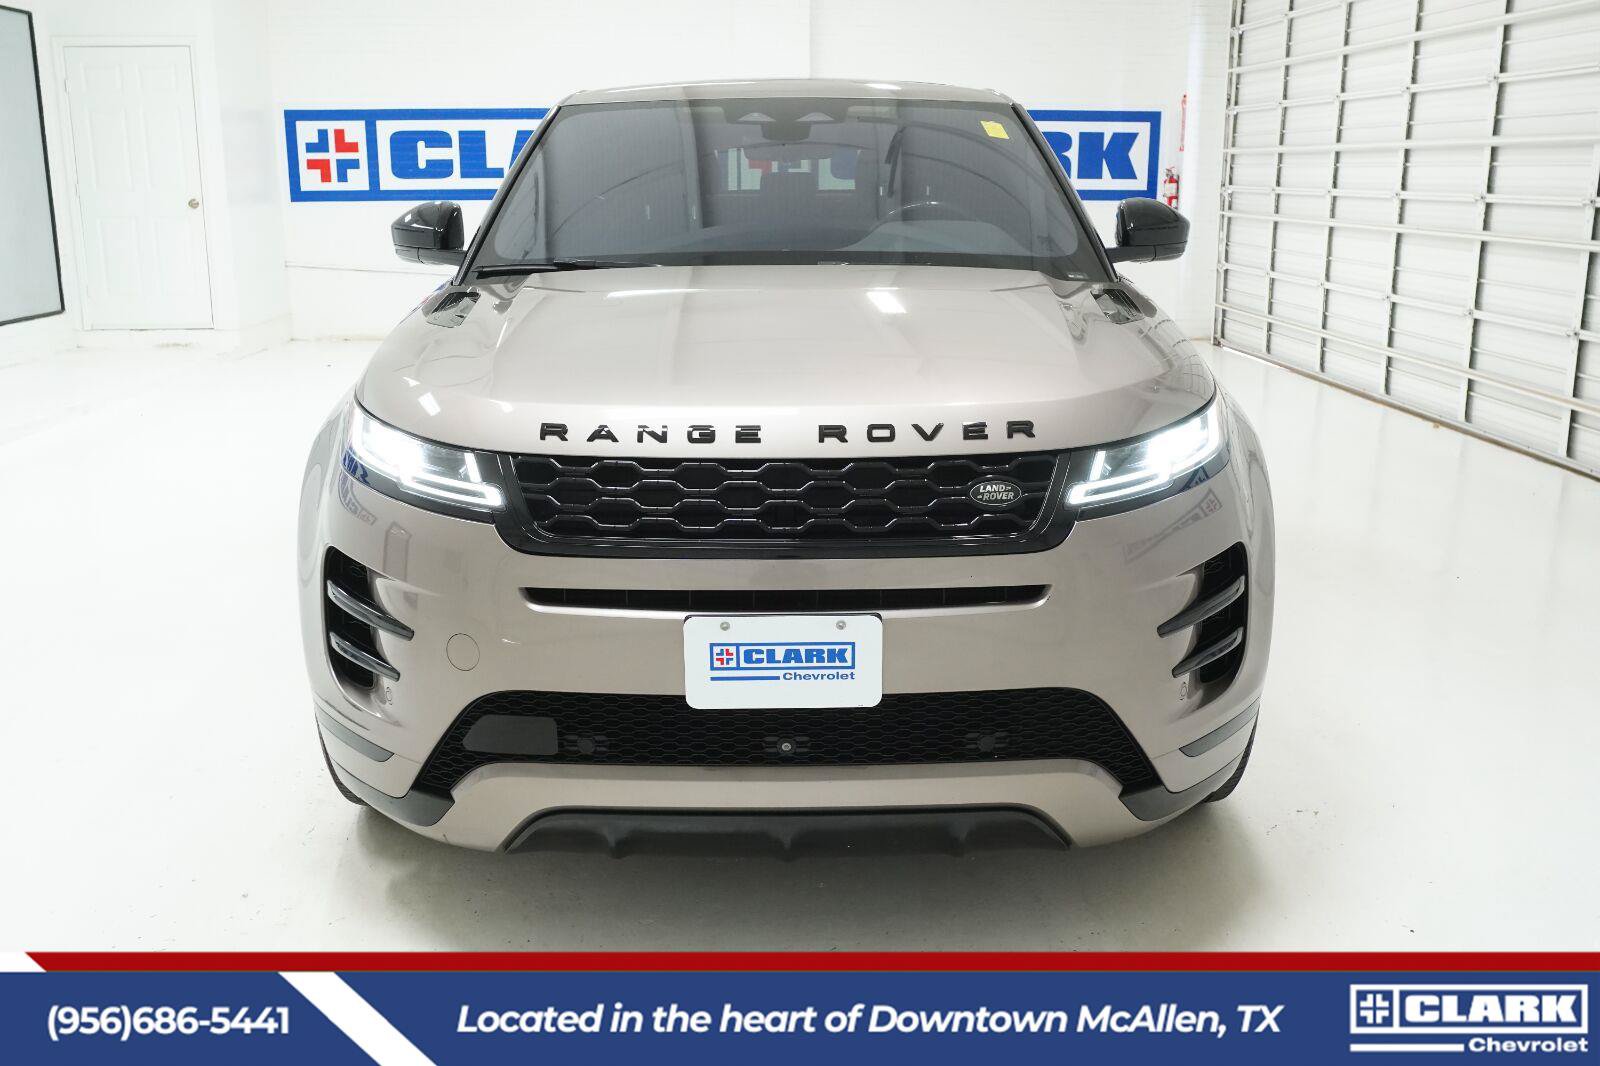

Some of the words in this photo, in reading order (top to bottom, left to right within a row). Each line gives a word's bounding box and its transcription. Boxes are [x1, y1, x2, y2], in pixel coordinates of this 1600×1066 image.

[539, 422, 762, 444] RANGE
[818, 420, 1036, 444] ROVER
[980, 484, 1006, 493] LAND
[983, 491, 1014, 501] ROVER
[743, 648, 848, 665] CLARK
[782, 671, 856, 681] Chevrolet
